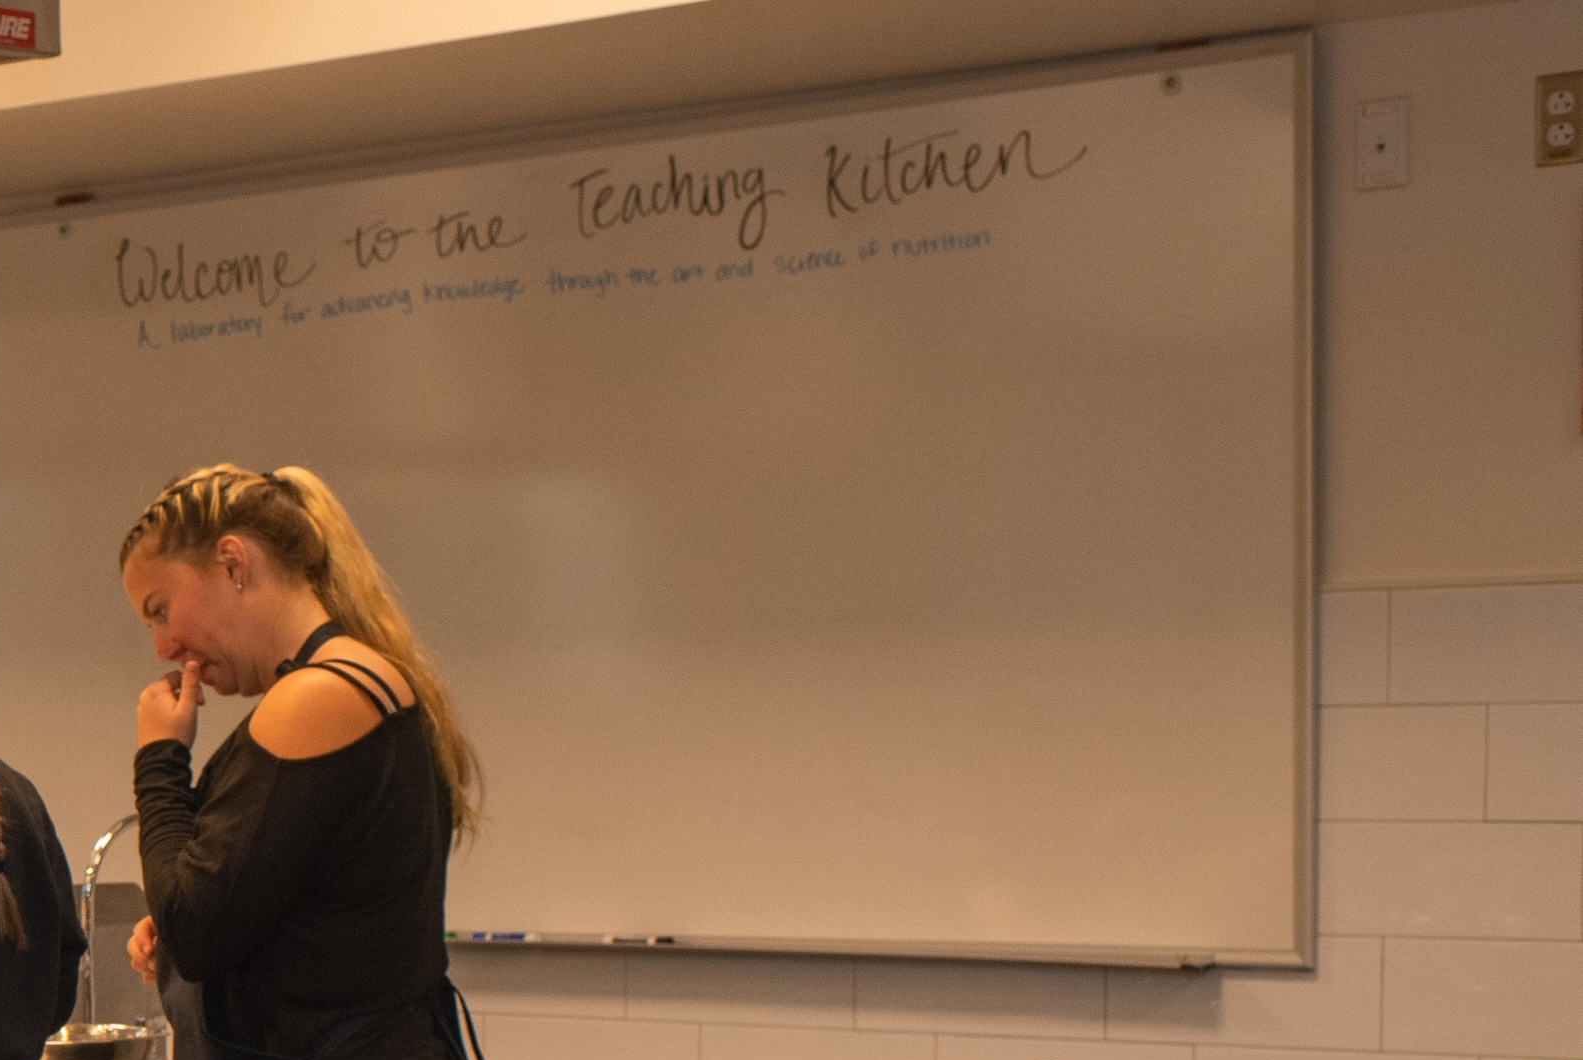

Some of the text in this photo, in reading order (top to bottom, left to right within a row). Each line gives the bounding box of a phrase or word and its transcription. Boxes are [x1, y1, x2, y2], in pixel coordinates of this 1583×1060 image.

[114, 130, 1087, 308] Welcome to the Teaching Kitchen
[282, 302, 312, 324] for
[628, 267, 660, 286] the
[715, 259, 754, 282] and
[858, 238, 880, 261] of
